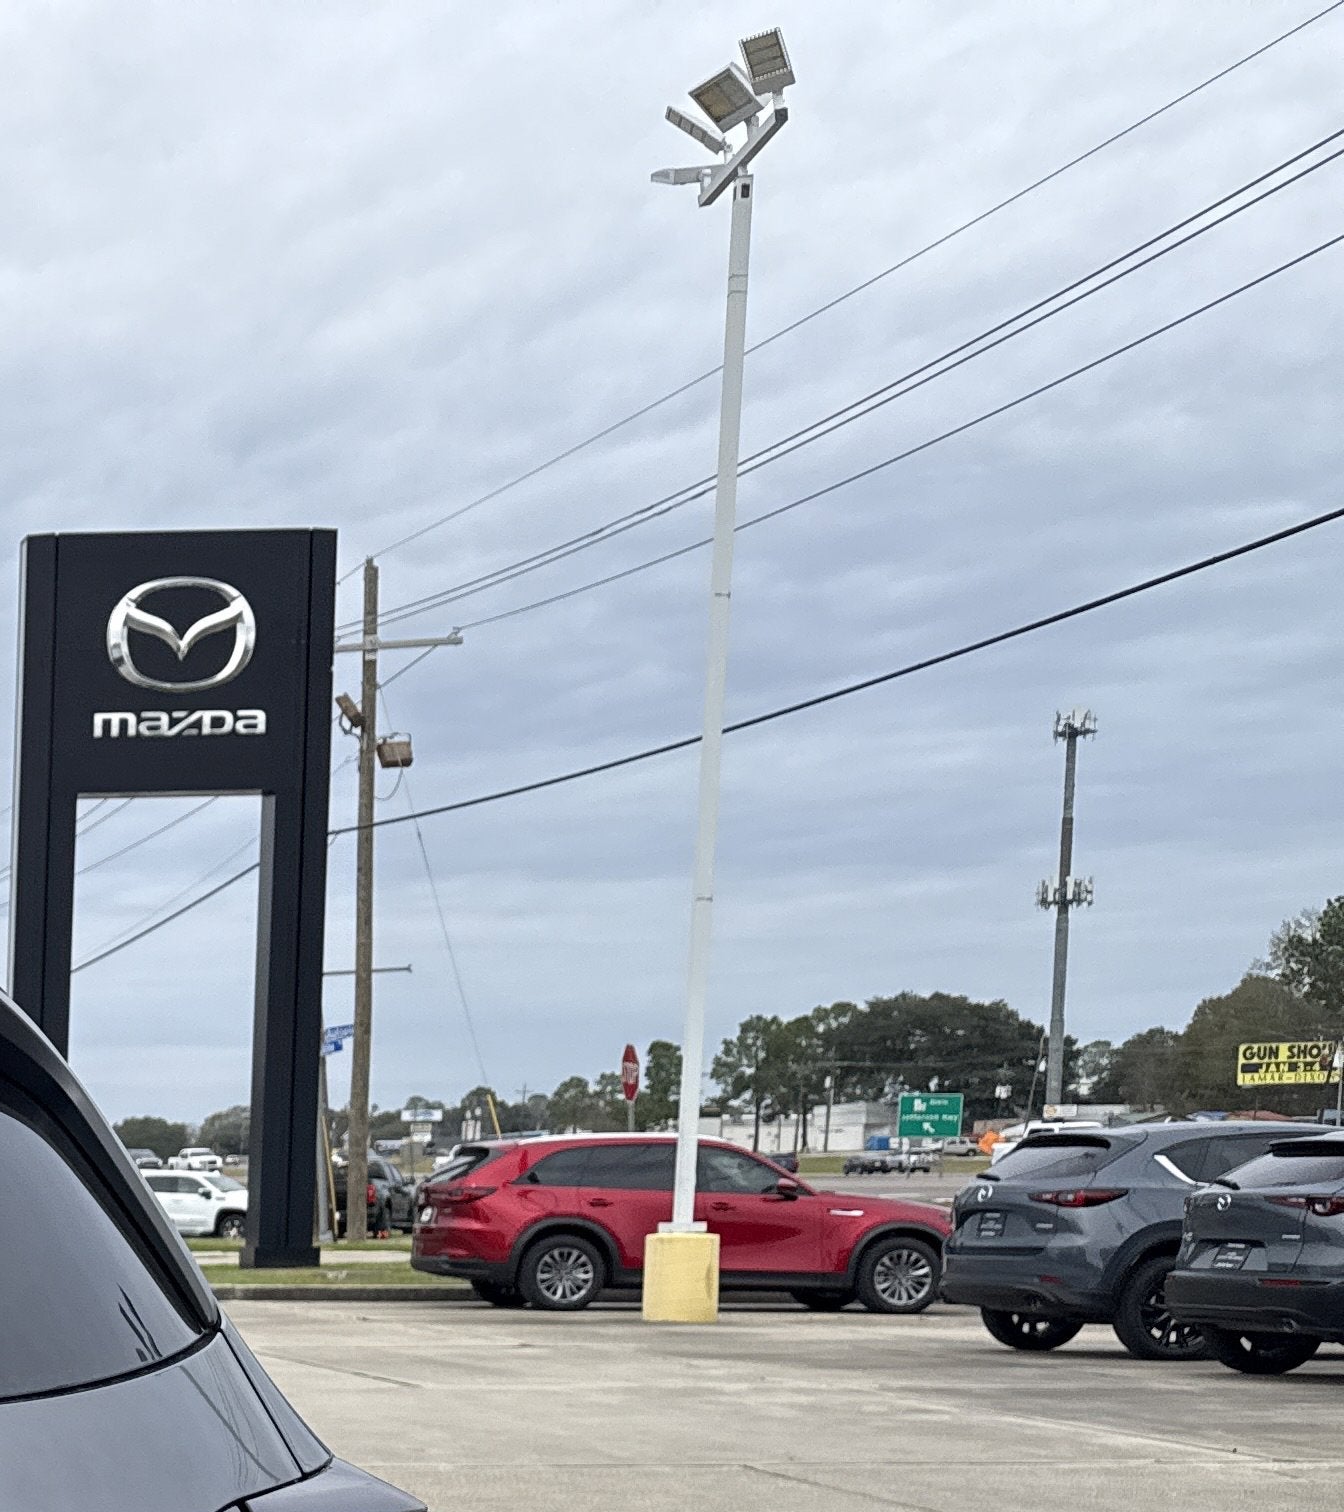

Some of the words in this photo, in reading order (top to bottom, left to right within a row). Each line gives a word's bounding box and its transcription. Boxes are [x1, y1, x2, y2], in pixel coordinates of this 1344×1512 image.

[93, 709, 267, 738] mazda
[1242, 1045, 1279, 1060] GUN
[623, 1061, 638, 1085] STOP
